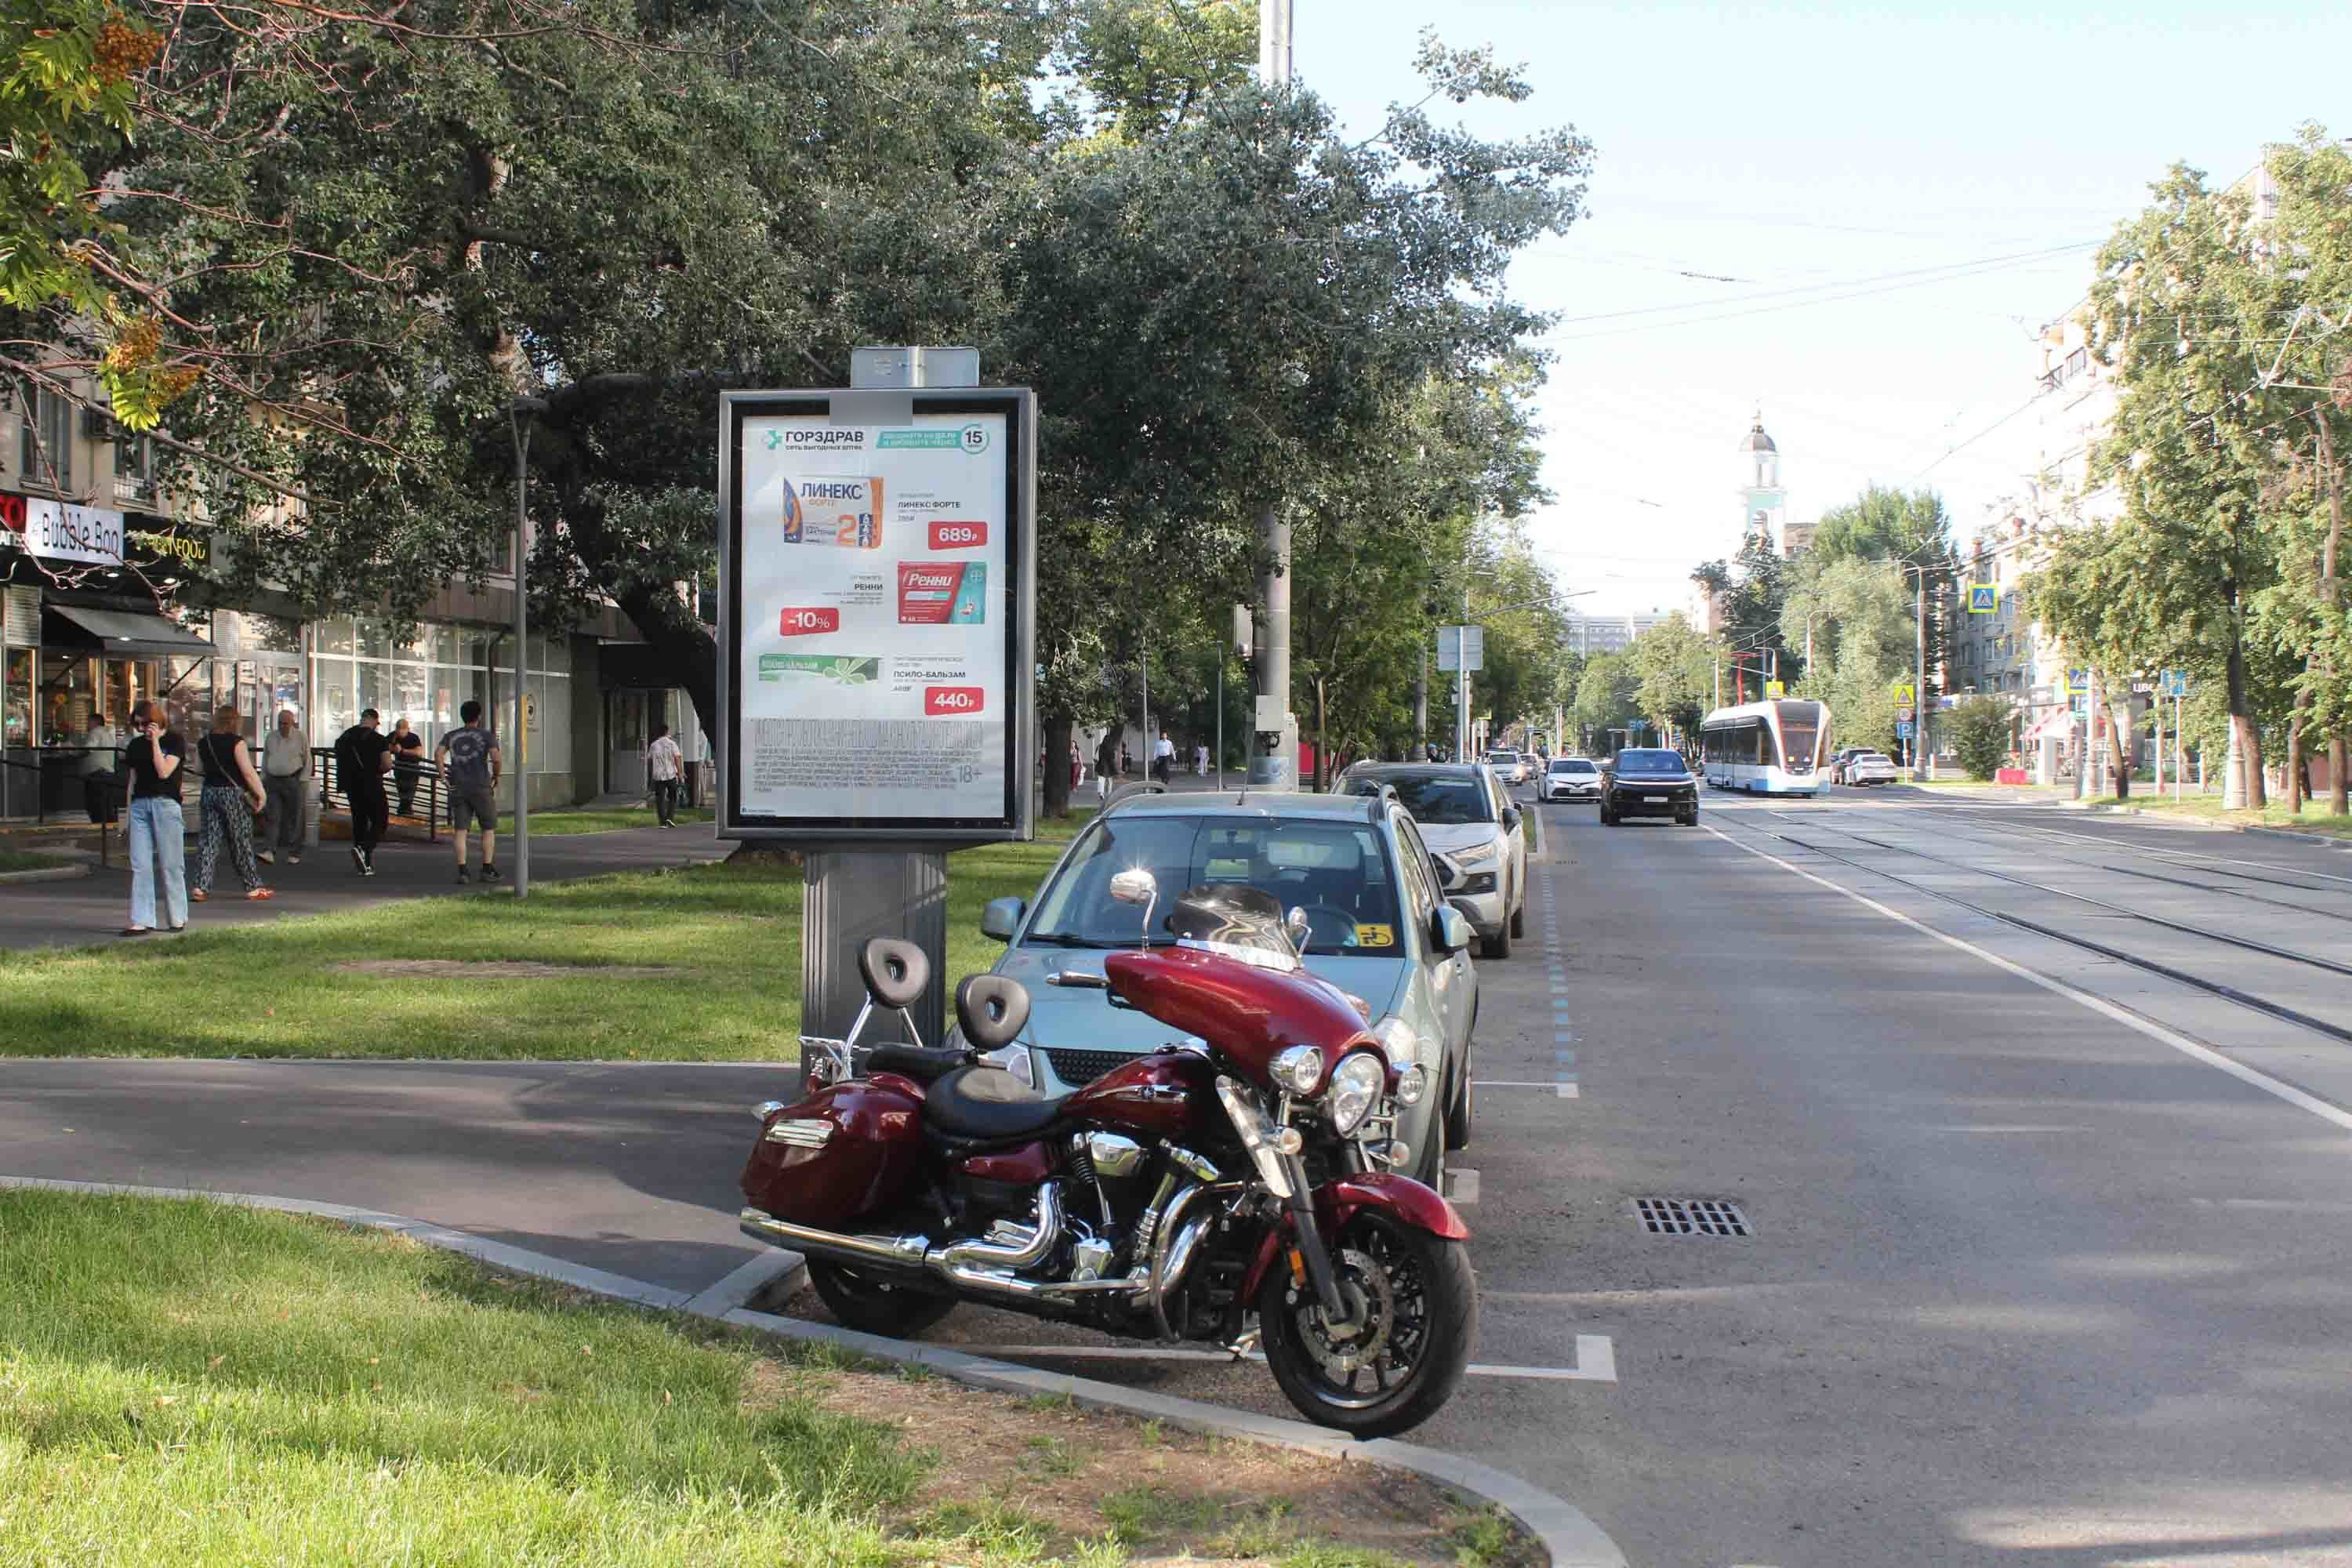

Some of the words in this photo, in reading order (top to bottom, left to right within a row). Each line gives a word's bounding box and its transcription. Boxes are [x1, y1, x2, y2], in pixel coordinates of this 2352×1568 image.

[786, 431, 864, 444] ГОРЗДРАВ
[965, 431, 982, 444] 15
[801, 482, 862, 500] ЛИНЕКС
[43, 512, 89, 553] Bubble
[909, 573, 953, 586] Ренни
[788, 612, 829, 628] -10%
[959, 764, 984, 783] 18+
